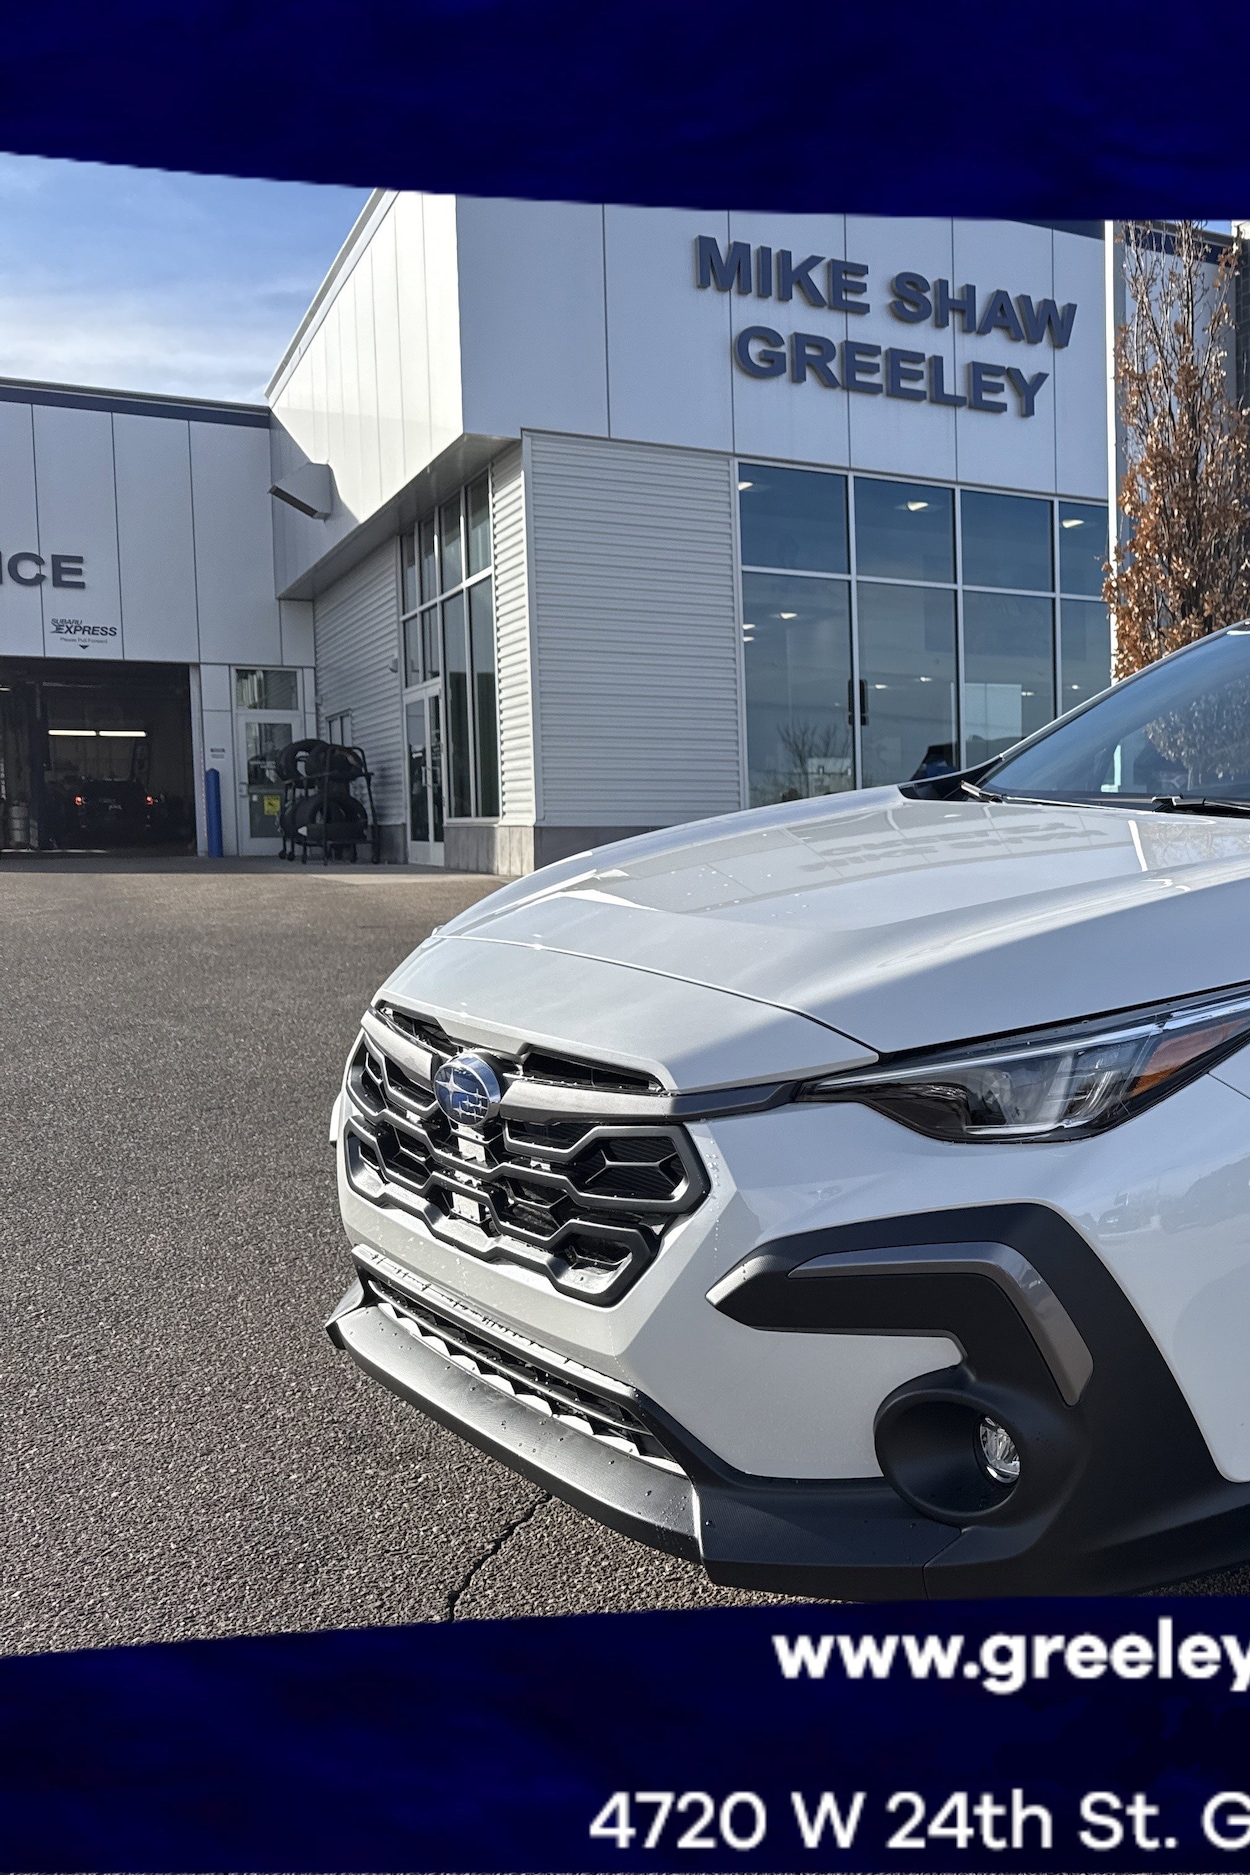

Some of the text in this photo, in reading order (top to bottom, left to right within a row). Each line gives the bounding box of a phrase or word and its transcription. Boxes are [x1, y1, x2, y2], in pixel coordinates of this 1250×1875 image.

[694, 235, 1078, 349] MIKE SHAW
[735, 325, 1050, 418] GREELEY
[52, 624, 118, 636] EXPRESS
